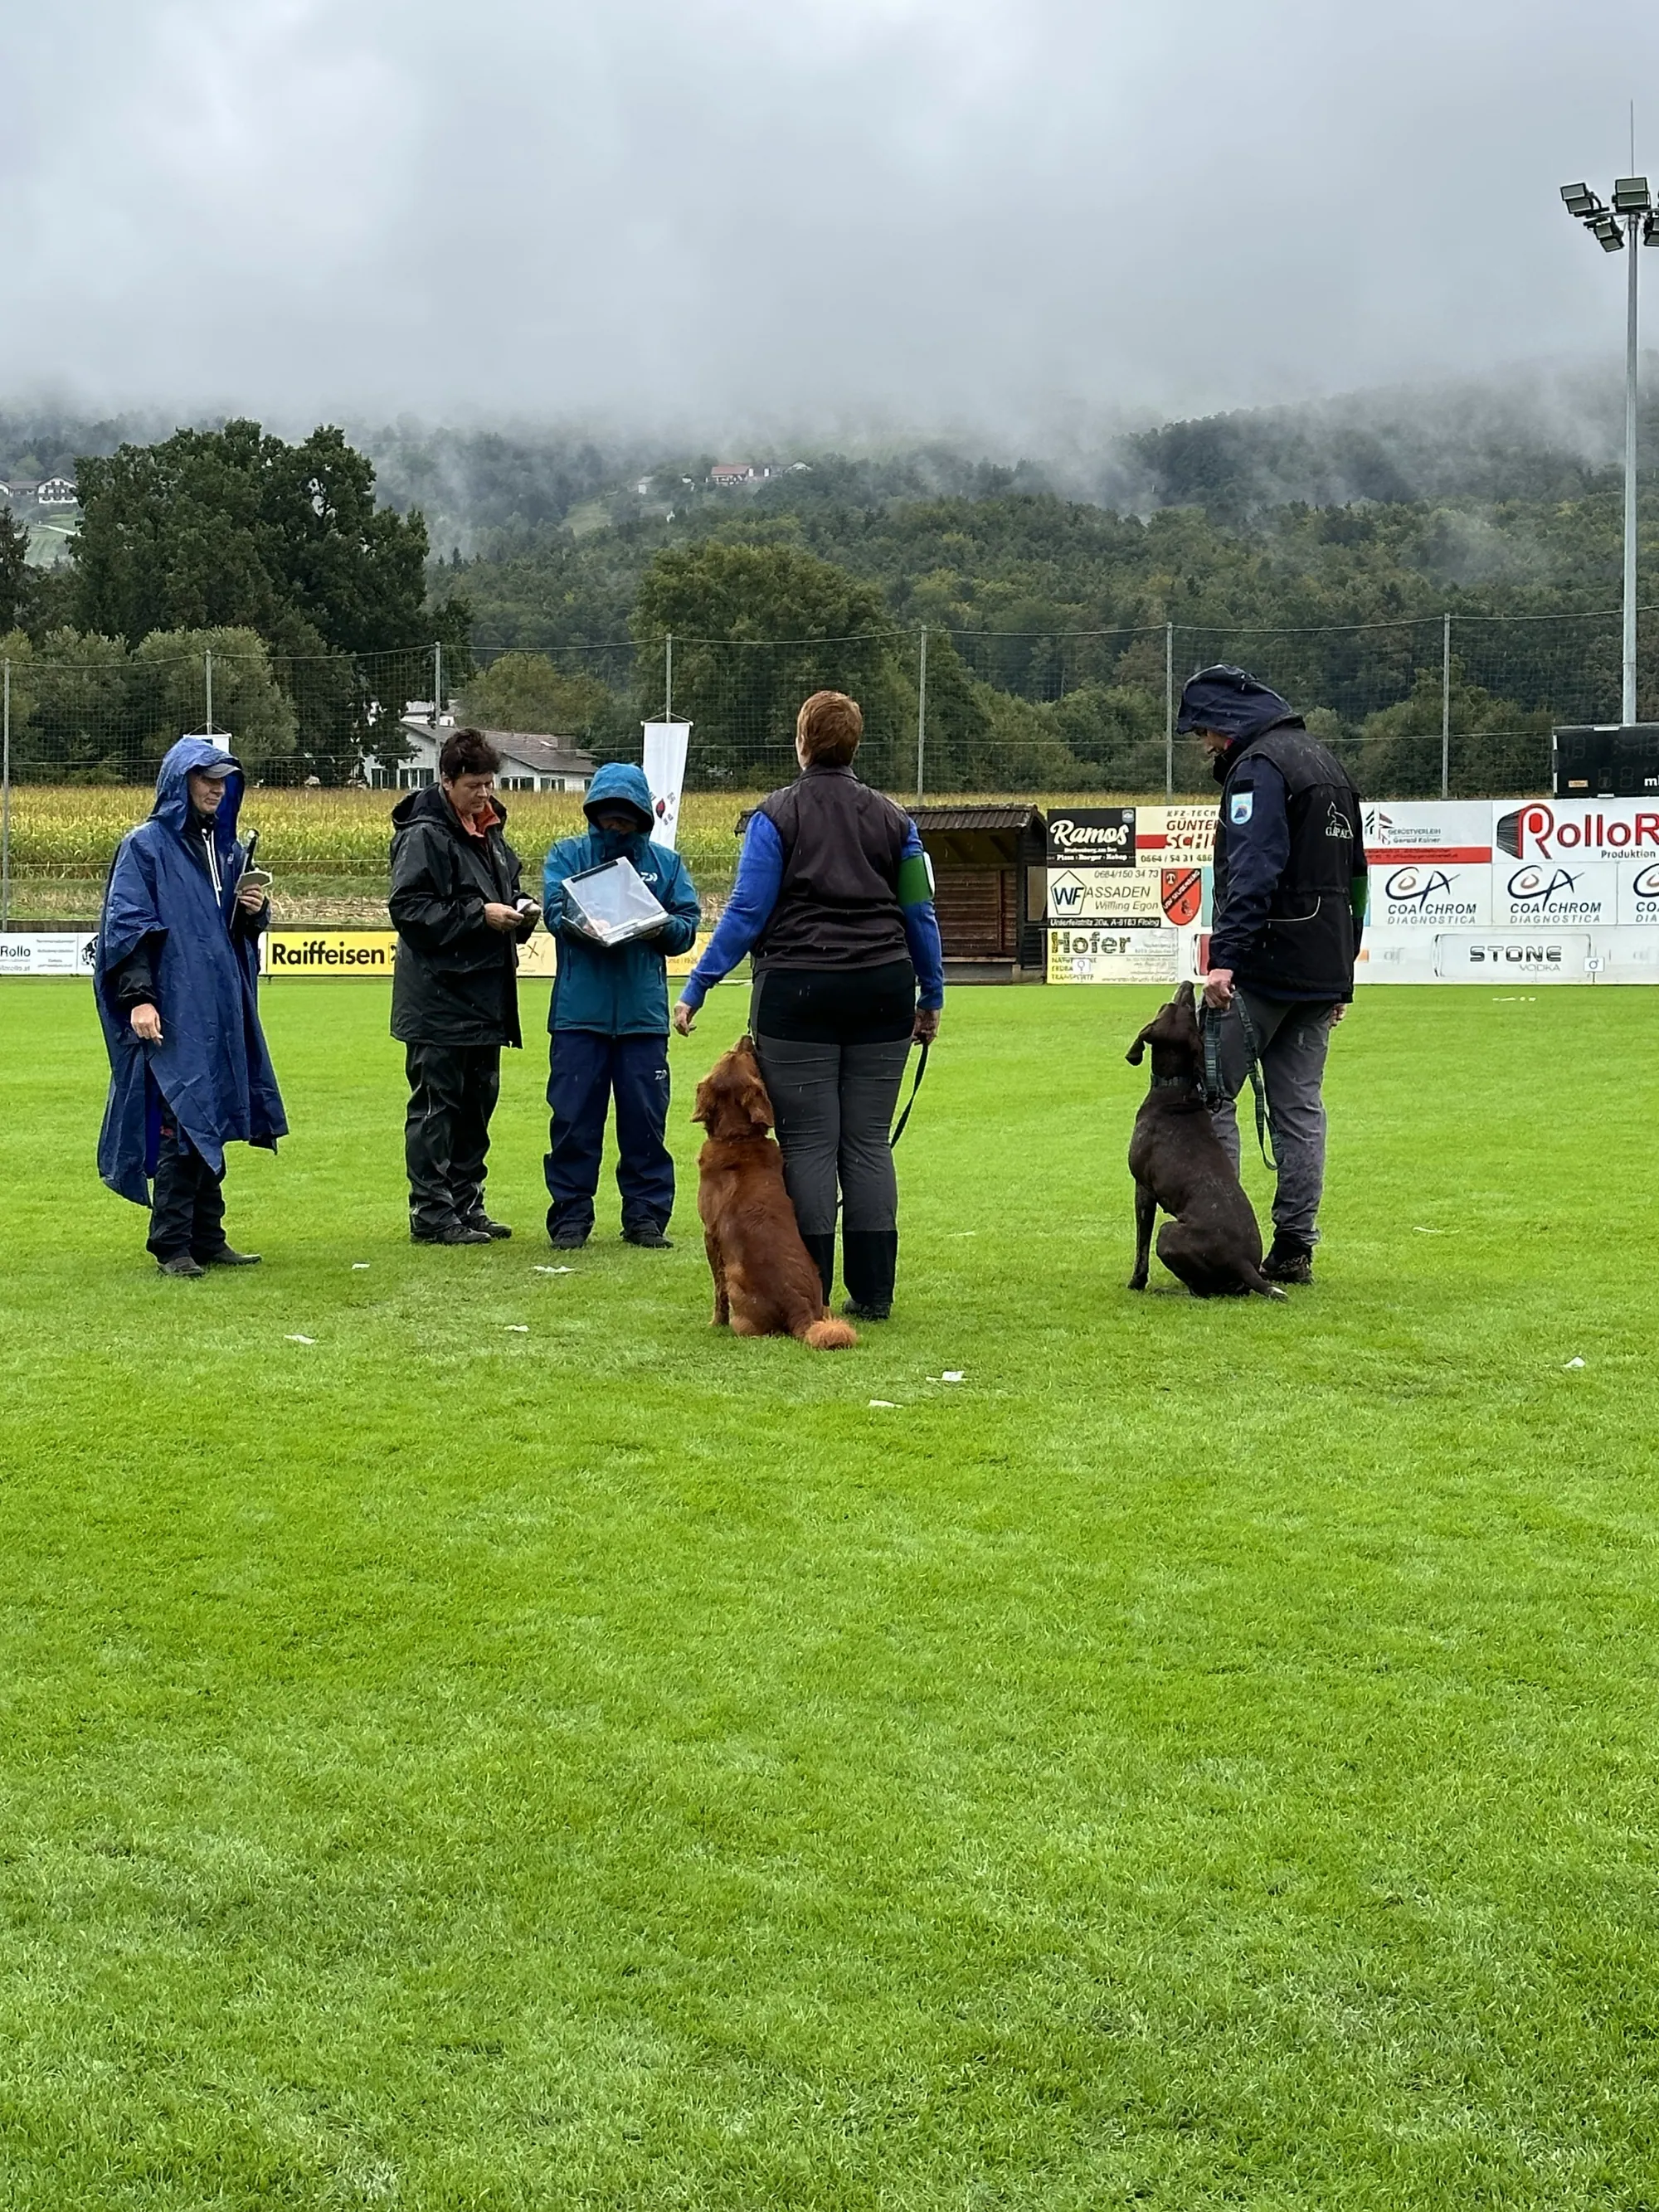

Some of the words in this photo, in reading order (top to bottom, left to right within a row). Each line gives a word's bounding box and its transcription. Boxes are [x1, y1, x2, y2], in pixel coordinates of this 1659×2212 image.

[1049, 819, 1129, 846] Ramos
[1601, 849, 1656, 858] Produktion
[1132, 901, 1159, 912] Egon
[1387, 916, 1477, 924] DIAGNOSTICA
[1510, 915, 1601, 924] DIAGNOSTICA
[1636, 914, 1657, 922] DIA
[1051, 931, 1131, 954] Hofer
[0, 946, 31, 957] Rollo
[272, 941, 385, 965] Raiffeisen
[1469, 946, 1562, 962] STONE
